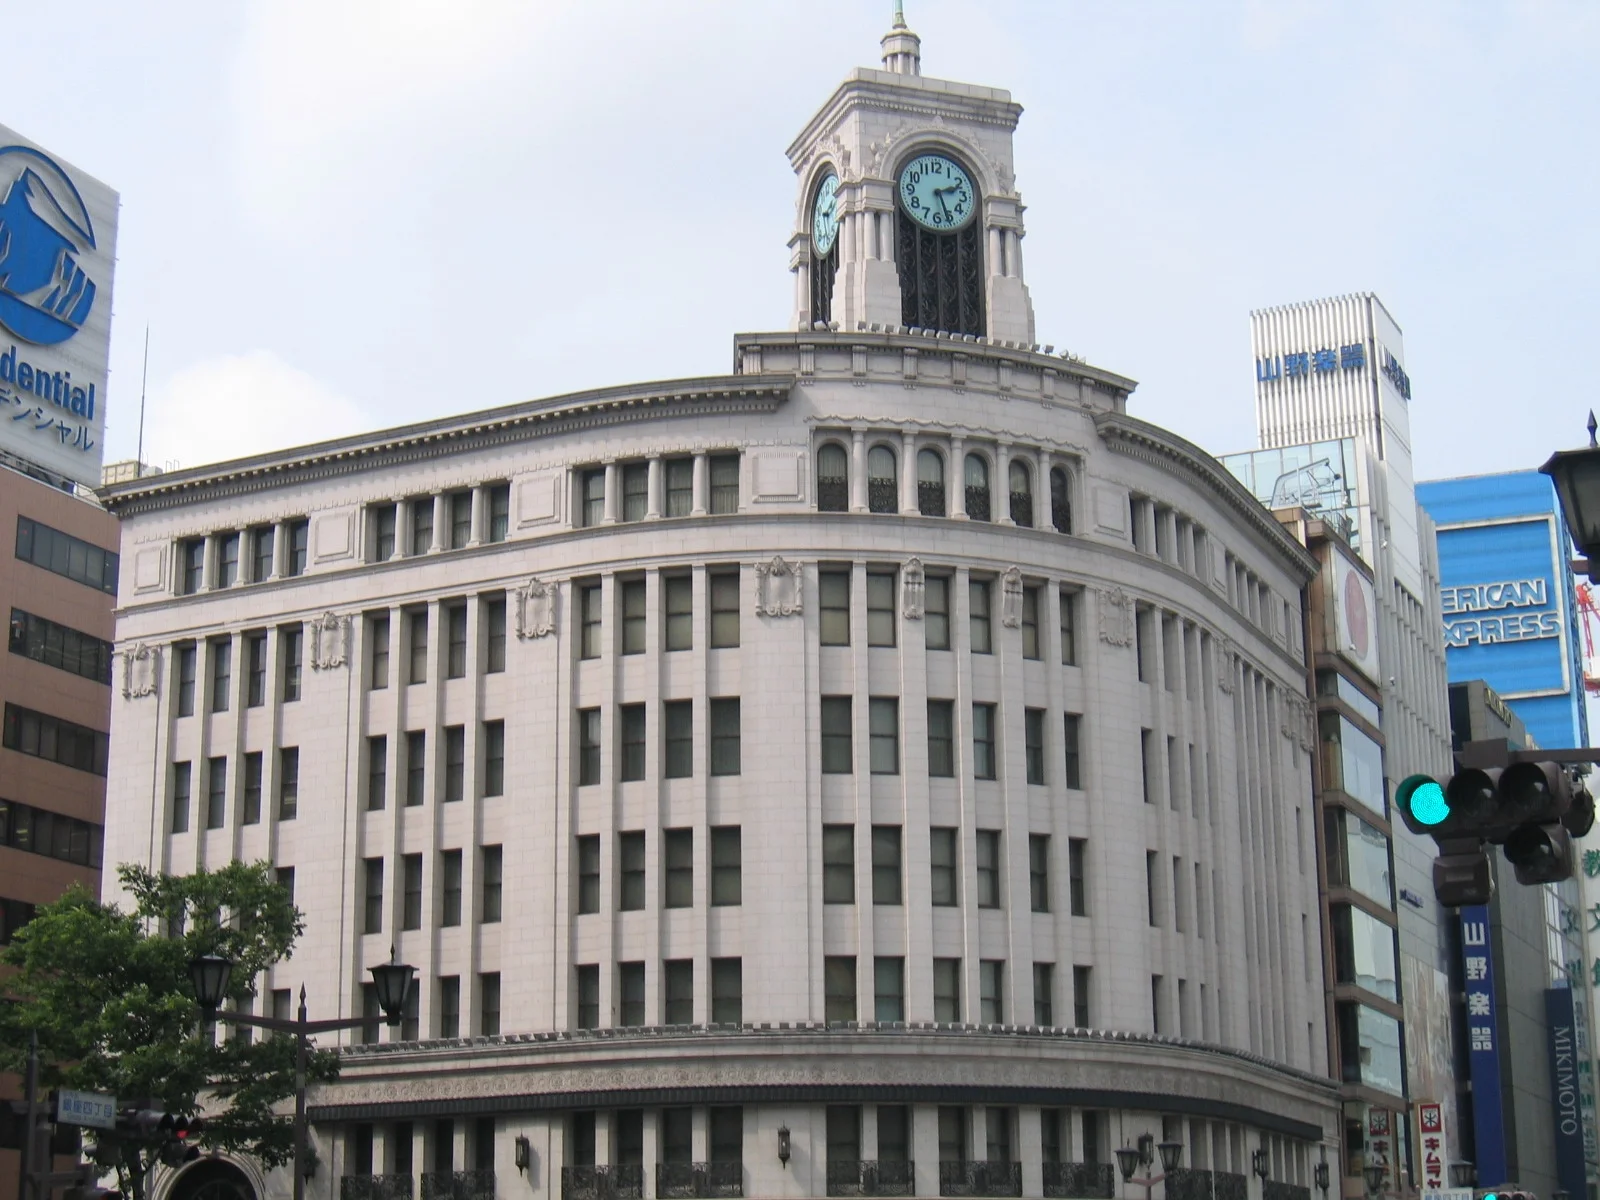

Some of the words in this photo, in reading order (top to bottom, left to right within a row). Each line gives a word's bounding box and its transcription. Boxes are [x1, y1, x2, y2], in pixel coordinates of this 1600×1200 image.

[920, 163, 929, 175] 11
[931, 162, 942, 174] 12
[910, 171, 920, 184] 10
[954, 177, 963, 190] 2
[906, 183, 915, 195] 9
[911, 196, 920, 209] 8
[959, 190, 968, 203] 3
[921, 206, 931, 219] 7
[954, 203, 964, 215] 4
[932, 212, 942, 224] 6
[0, 345, 95, 420] dential
[1442, 610, 1562, 649] XPRESS
[1463, 922, 1493, 1051] 山野楽器
[1553, 1026, 1578, 1136] MIKIMOTO
